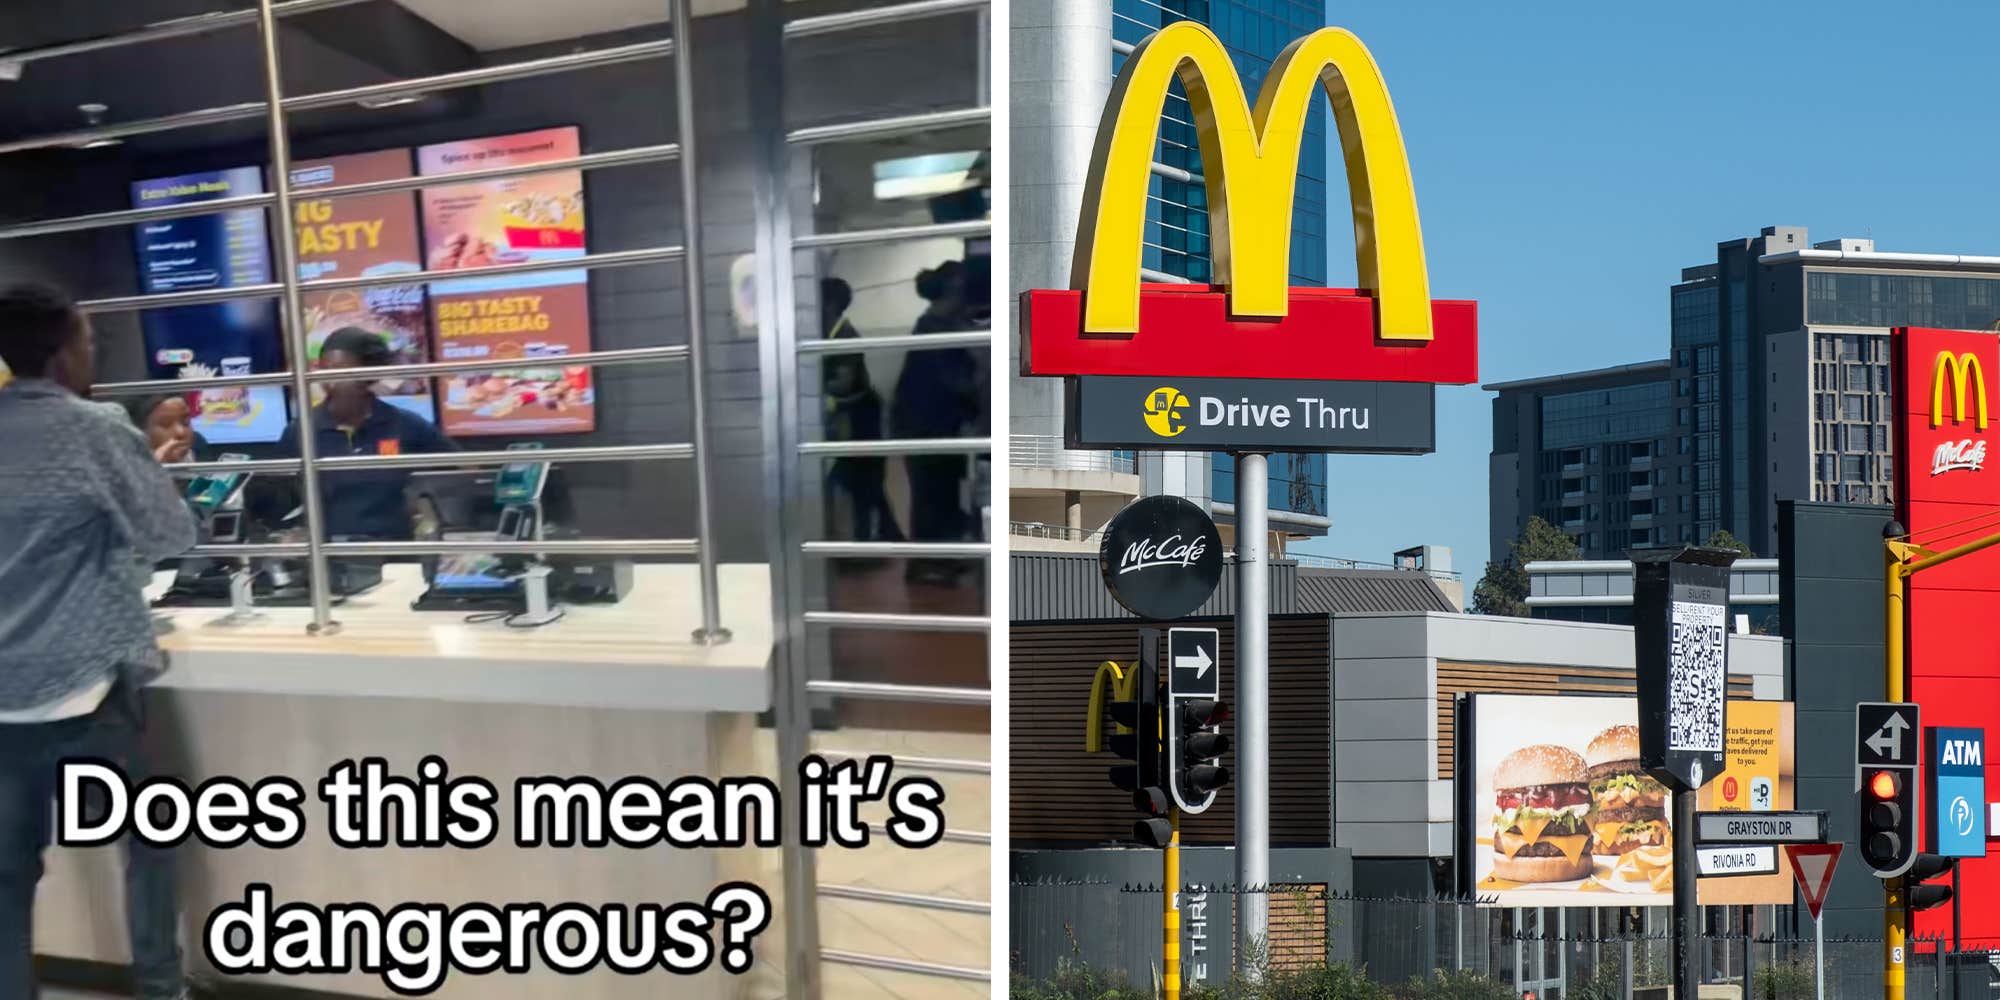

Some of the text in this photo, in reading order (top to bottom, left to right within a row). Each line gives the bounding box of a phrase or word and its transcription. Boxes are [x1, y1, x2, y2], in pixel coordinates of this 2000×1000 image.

[297, 199, 332, 223] IG
[298, 219, 384, 255] ASTY
[438, 296, 542, 318] BIG TASTY
[439, 313, 550, 337] SHAREBAG
[1199, 396, 1369, 430] Drive Thru
[1931, 439, 1987, 474] McCafé
[1119, 534, 1207, 575] McCafé
[1687, 588, 1711, 600] SILVER
[1682, 614, 1713, 625] PROPERTY
[1740, 727, 1753, 735] take
[1731, 737, 1750, 745] traffic,
[1750, 739, 1761, 747] get
[1761, 739, 1774, 748] your
[1741, 747, 1768, 756] delivered
[1941, 739, 1982, 766] ATM
[1727, 820, 1792, 836] GRAYSTON DR
[1713, 853, 1756, 869] RIVONIA RD
[1894, 948, 1902, 962] 3
